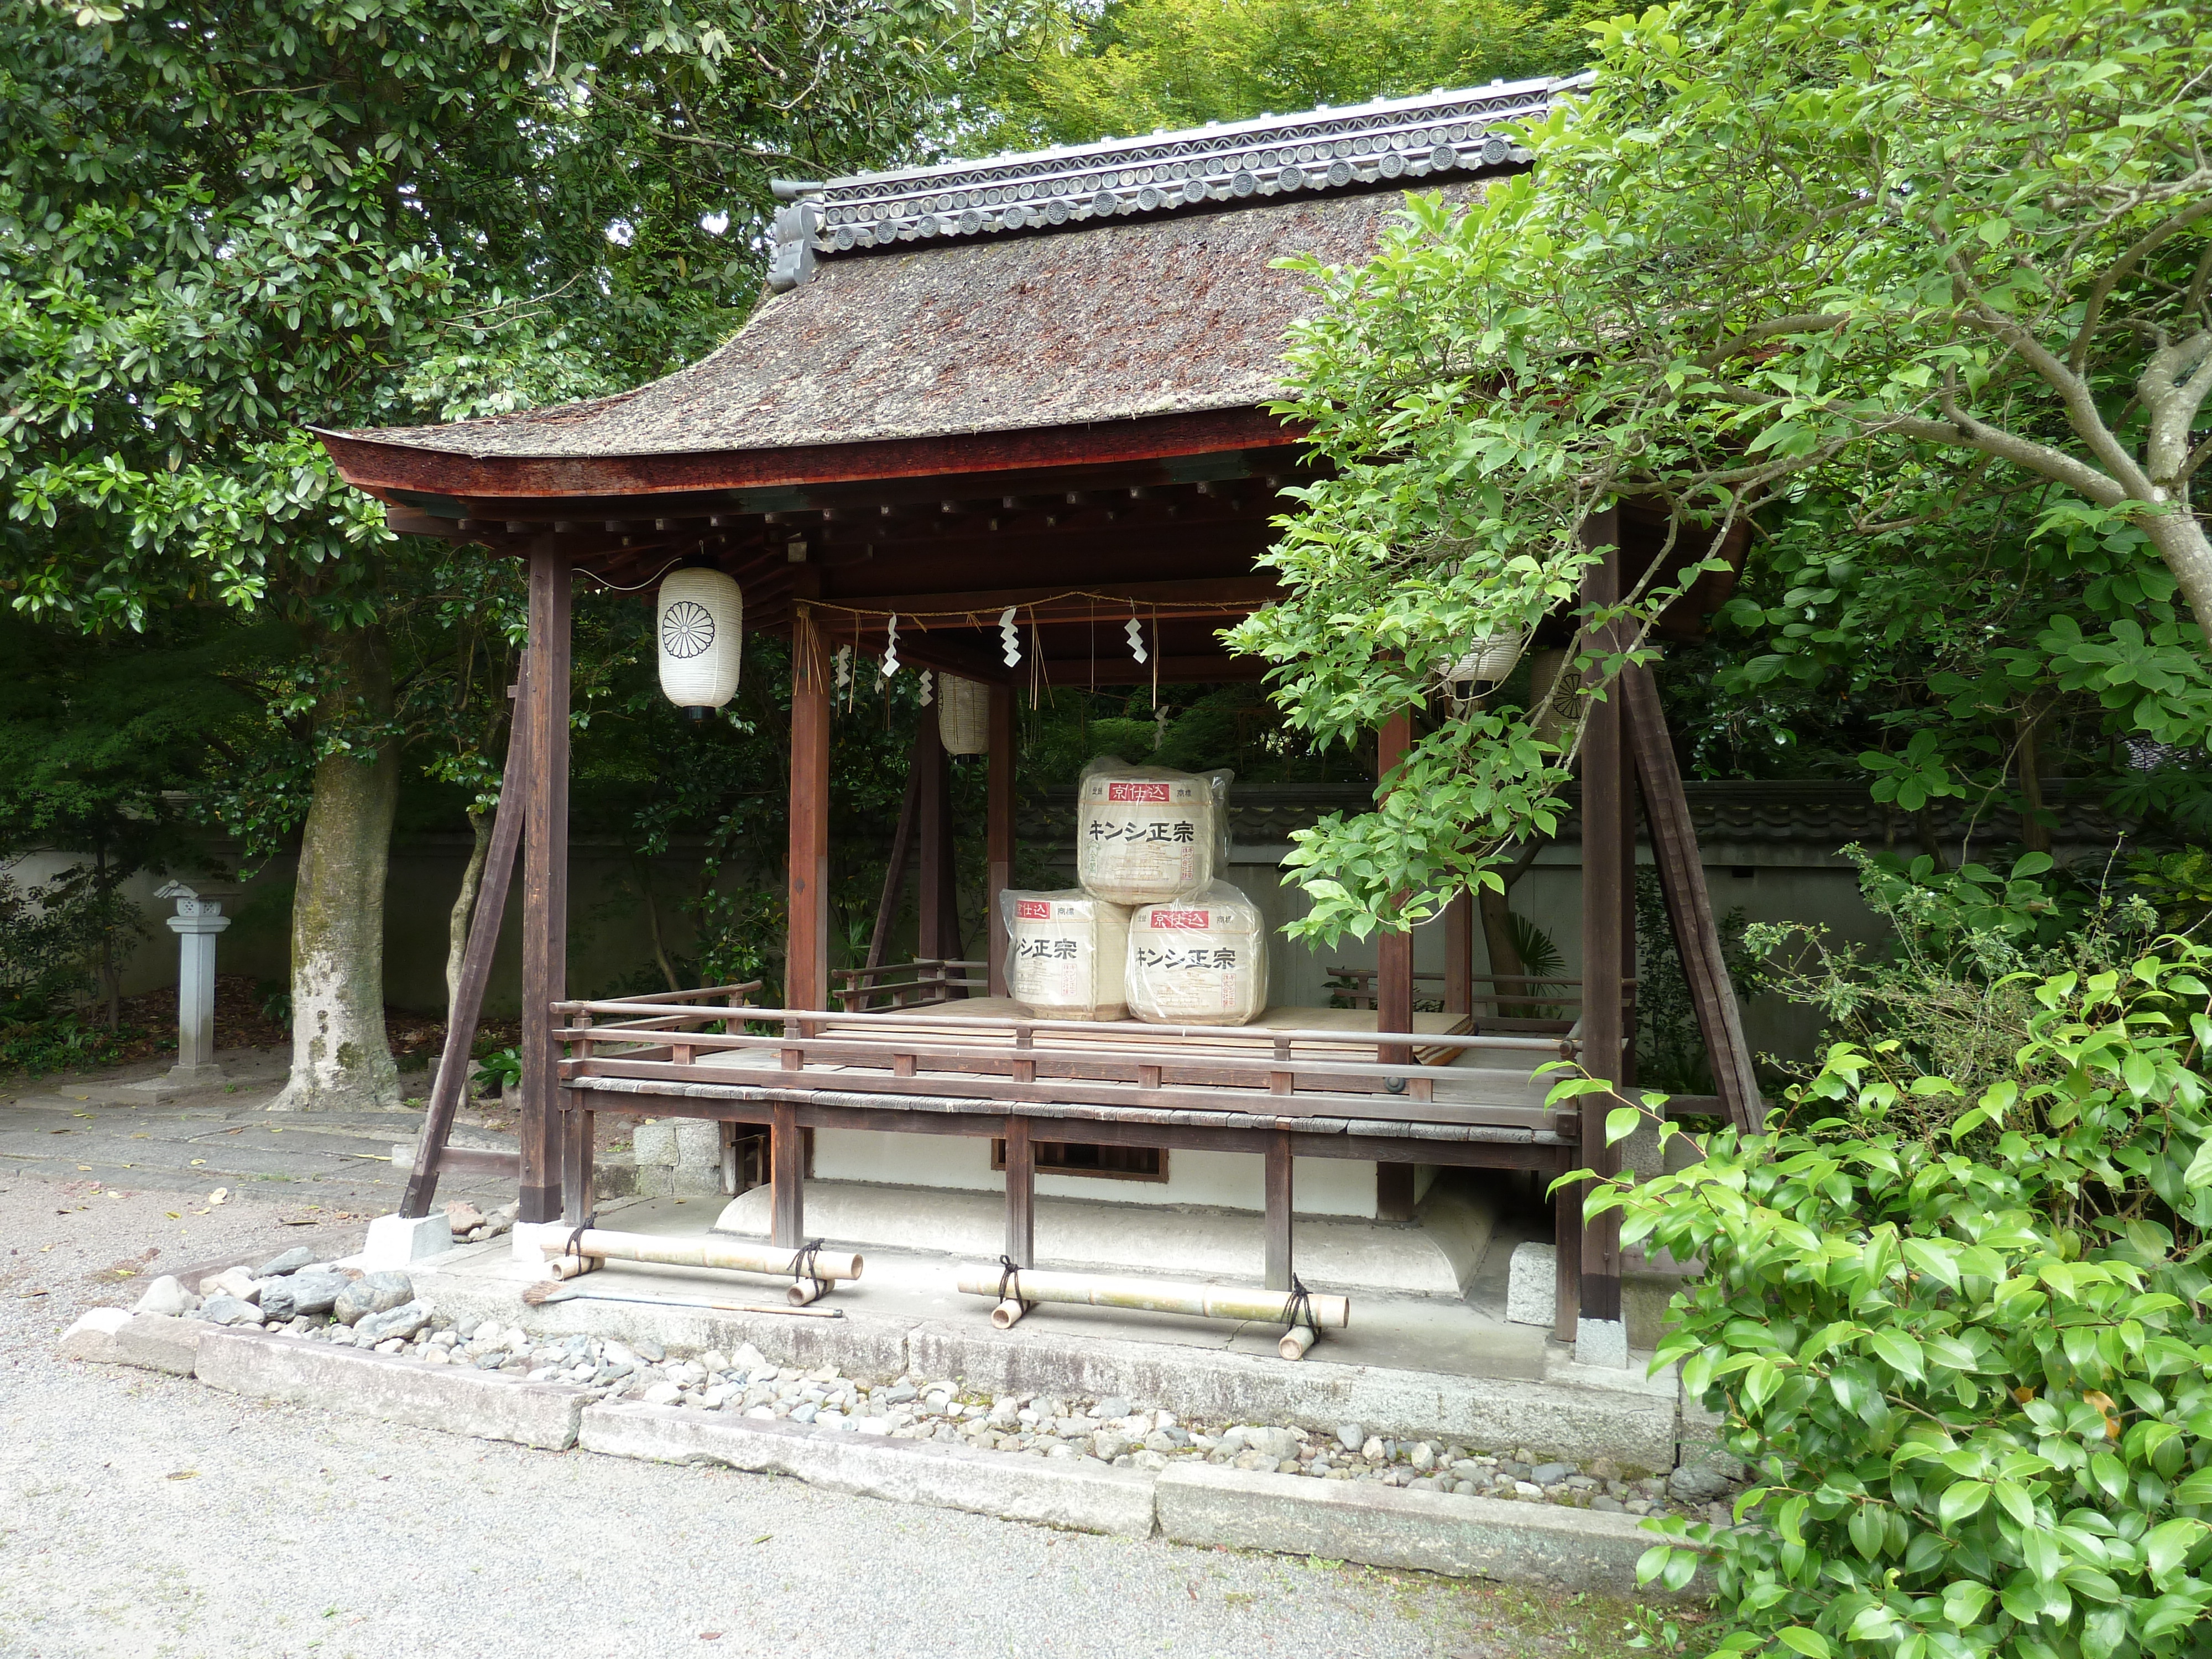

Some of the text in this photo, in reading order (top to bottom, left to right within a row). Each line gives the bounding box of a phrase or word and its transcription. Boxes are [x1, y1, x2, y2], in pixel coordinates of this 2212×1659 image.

[1112, 784, 1166, 802] 京仕込
[1177, 789, 1192, 797] 商標
[1089, 820, 1194, 843] キンシ正宗
[1152, 912, 1206, 927] 京仕込
[1135, 947, 1237, 969] キンシ正宗
